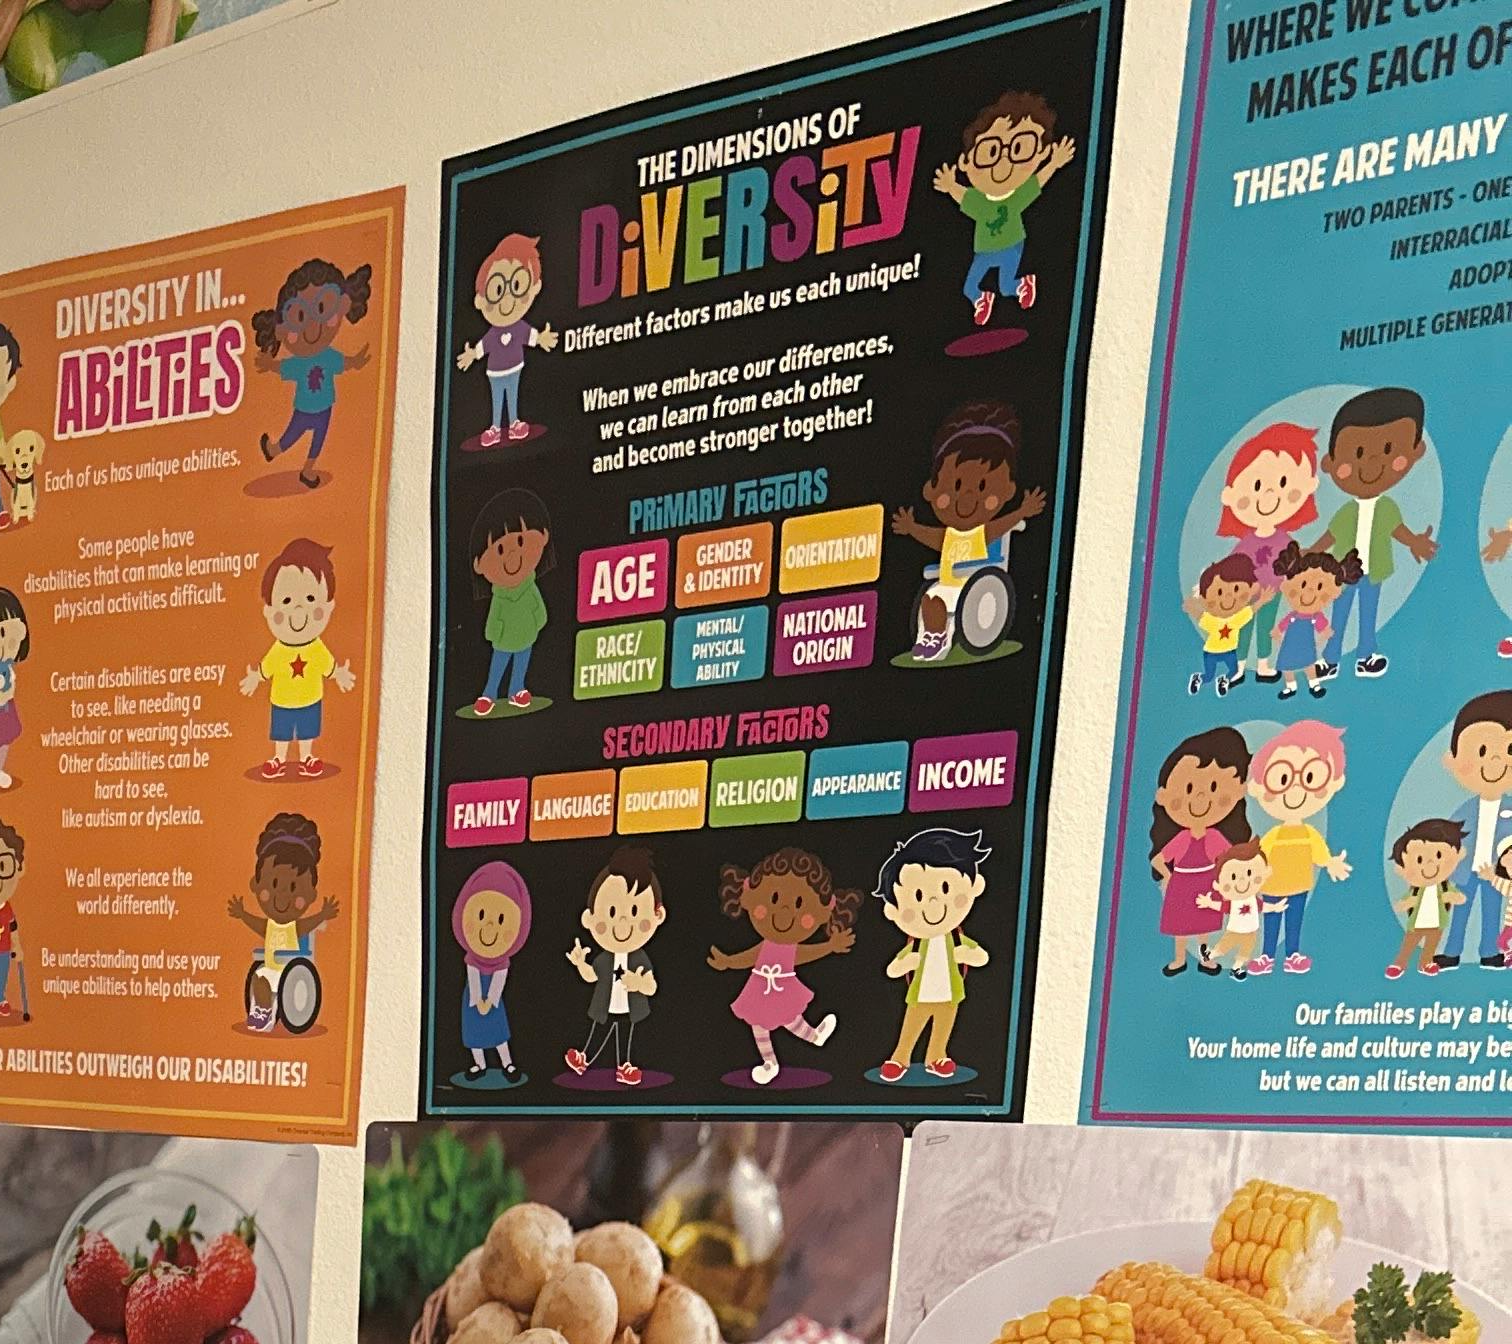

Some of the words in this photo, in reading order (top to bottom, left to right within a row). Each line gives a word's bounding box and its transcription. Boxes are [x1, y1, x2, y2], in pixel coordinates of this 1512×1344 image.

[1226, 0, 1337, 63] WHERE
[1247, 57, 1359, 123] MAKES
[1367, 33, 1458, 95] EACH
[637, 150, 677, 187] THE
[681, 113, 822, 176] DIMENSIONS
[828, 103, 861, 139] OF
[1233, 153, 1328, 207] THERE
[1332, 137, 1398, 186] ARE
[1404, 113, 1508, 171] MANY
[1324, 206, 1365, 233] TWO
[1370, 187, 1454, 224] PARENTS
[56, 275, 190, 339] DIVERSITY
[564, 316, 642, 352] Different
[646, 306, 710, 335] factors
[714, 291, 765, 321] make
[769, 288, 791, 309] us
[796, 272, 841, 303] each
[846, 253, 921, 292] unique!
[1340, 316, 1427, 351] MULTIPLE
[583, 387, 629, 412] When
[633, 382, 658, 402] we
[662, 366, 739, 396] embrace
[743, 358, 776, 380] our
[779, 335, 893, 373] differences,
[600, 421, 624, 440] we
[627, 414, 658, 435] can
[662, 404, 708, 428] learn
[713, 394, 757, 418] from
[761, 380, 805, 409] each
[810, 372, 863, 400] other
[593, 446, 624, 473] and
[628, 439, 696, 467] become
[700, 423, 779, 454] stronger
[783, 399, 873, 442] together!
[45, 468, 74, 492] Each
[76, 465, 92, 488] of
[93, 469, 108, 486] us
[110, 462, 133, 483] has
[135, 457, 180, 482] unique
[182, 447, 241, 473] abilities.
[696, 538, 752, 566] GENDER
[784, 534, 878, 569] ORIENTATION
[590, 553, 656, 605] AGE
[684, 572, 696, 594] &
[698, 562, 763, 592] IDENTITY
[696, 615, 744, 638] MENTAL/
[783, 604, 867, 638] NATIONAL
[596, 630, 642, 659] RACE/
[692, 638, 745, 660] PHYSICAL
[793, 635, 853, 665] ORIGIN
[580, 657, 657, 688] ETHNICITY
[696, 660, 740, 681] ABILITY
[603, 715, 731, 759] SECONDARY
[716, 776, 798, 806] RELIGION
[812, 771, 902, 797] APPEARANCE
[918, 757, 1006, 791] INCOME
[454, 799, 520, 830] FAMILY
[534, 794, 612, 821] LANGUAGE
[625, 788, 700, 812] EDUCATION
[77, 894, 109, 914] world
[112, 894, 179, 919] differently.
[1296, 1003, 1331, 1025] Our
[1335, 1002, 1415, 1025] families
[1419, 1001, 1465, 1030] play
[1469, 1007, 1482, 1024] a
[1188, 1037, 1227, 1058] Your
[1230, 1037, 1282, 1058] home
[1285, 1036, 1317, 1058] life
[1321, 1036, 1358, 1058] and
[1362, 1036, 1432, 1058] culture
[1436, 1041, 1482, 1064] may
[6, 1049, 73, 1075] ABILITIES
[76, 1052, 153, 1079] OUTWEIGH
[156, 1056, 191, 1081] OUR
[195, 1058, 307, 1087] DISABILITIES!
[1260, 1070, 1291, 1091] but
[1296, 1075, 1322, 1091] we
[1326, 1075, 1360, 1091] can
[1364, 1069, 1390, 1091] all
[1394, 1069, 1451, 1092] listen
[1455, 1069, 1496, 1092] and
